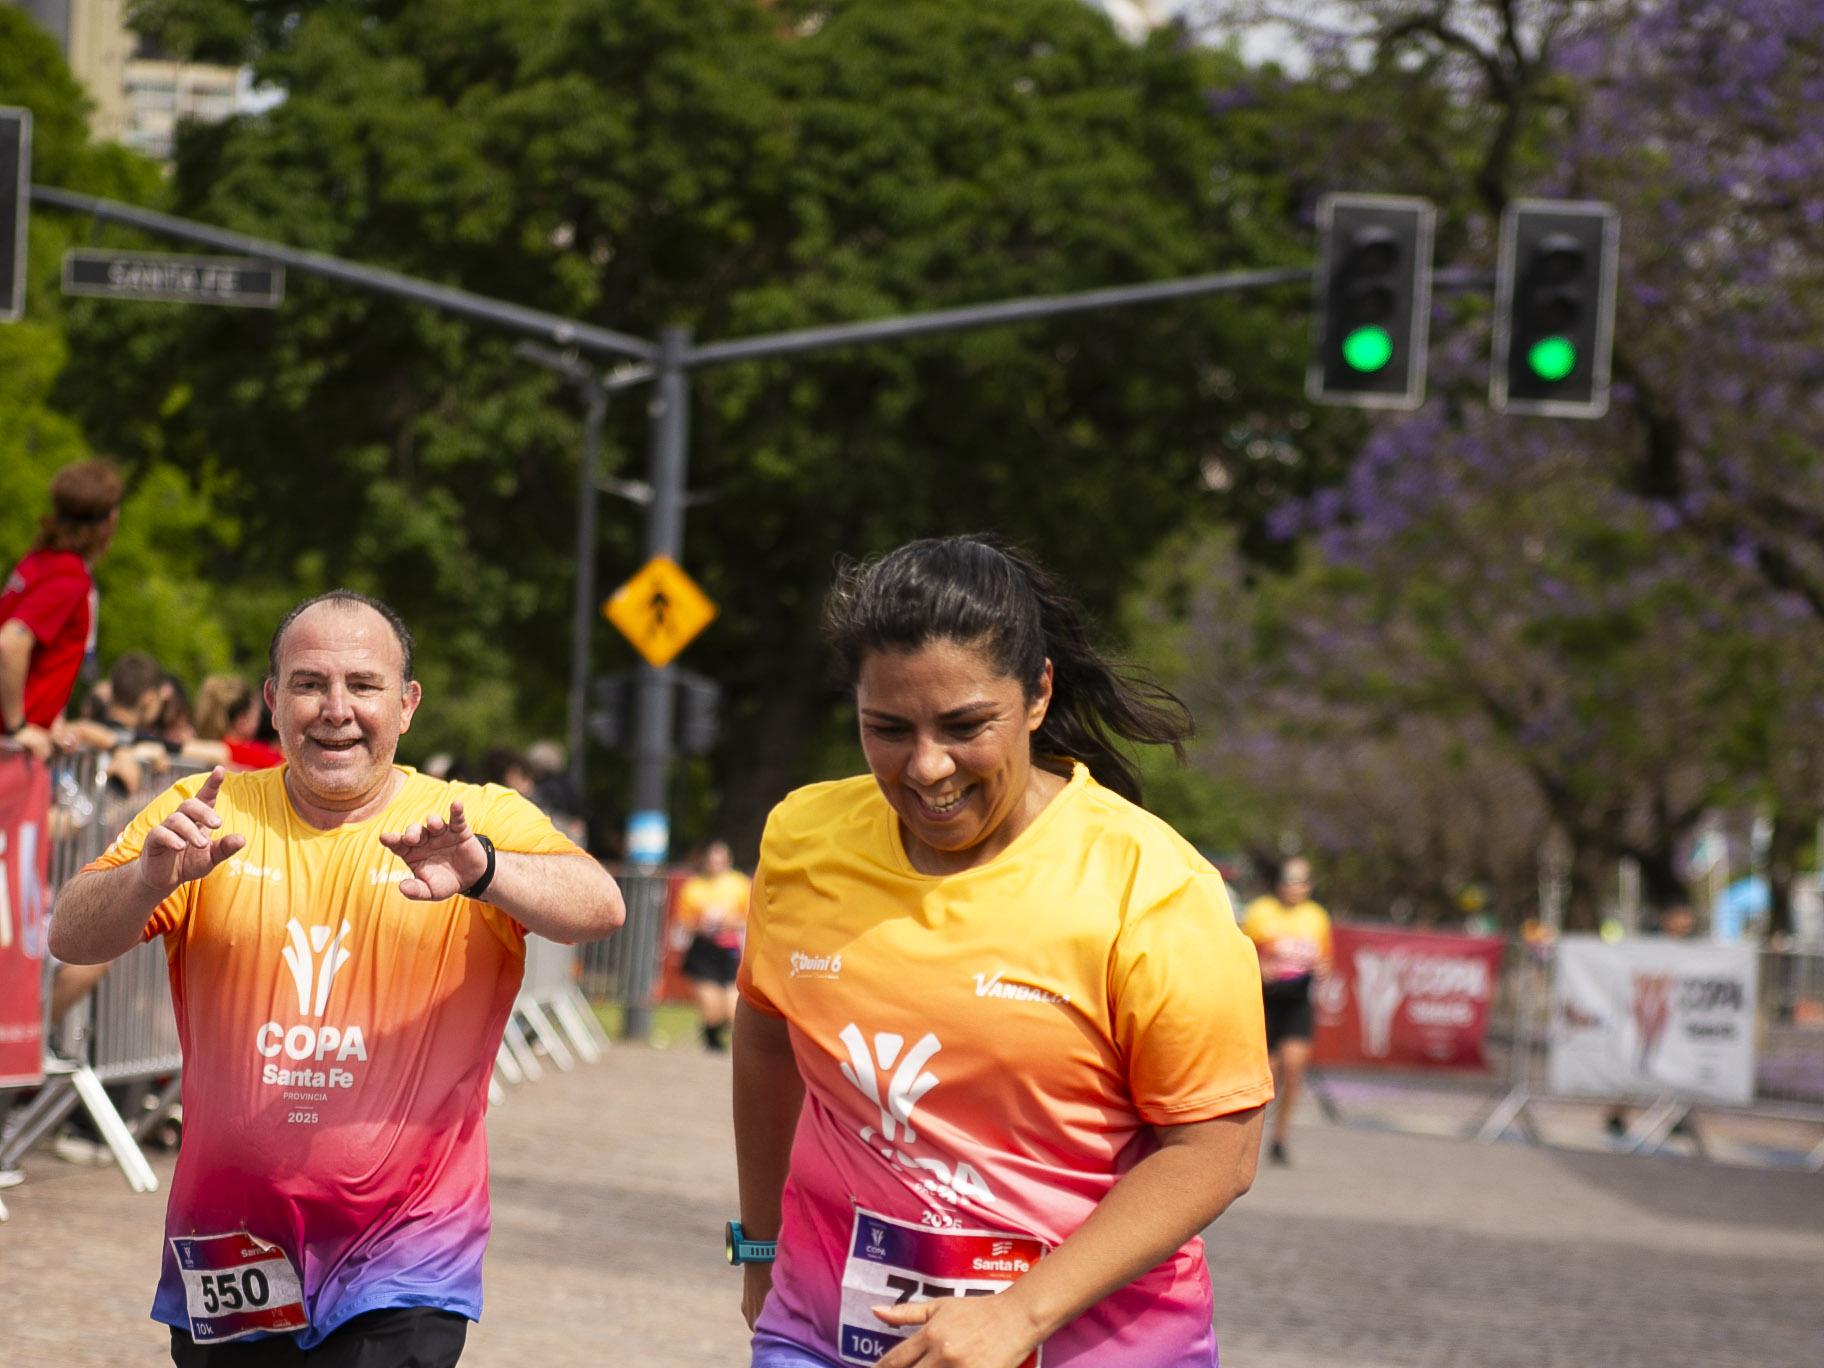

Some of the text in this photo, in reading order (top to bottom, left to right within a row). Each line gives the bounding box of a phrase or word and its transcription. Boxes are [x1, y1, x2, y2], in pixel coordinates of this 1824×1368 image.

[107, 261, 238, 298] SANTA FE
[831, 955, 842, 973] 6
[256, 1021, 368, 1061] COPA
[262, 1063, 354, 1088] Santa Fe
[282, 1091, 328, 1101] PROVINCIA
[287, 1112, 319, 1124] 2025
[865, 1245, 887, 1256] COPA
[972, 1258, 1030, 1272] Santa Fe
[200, 1267, 270, 1314] 550
[196, 1323, 215, 1336] 10k
[851, 1335, 885, 1357] 10k
